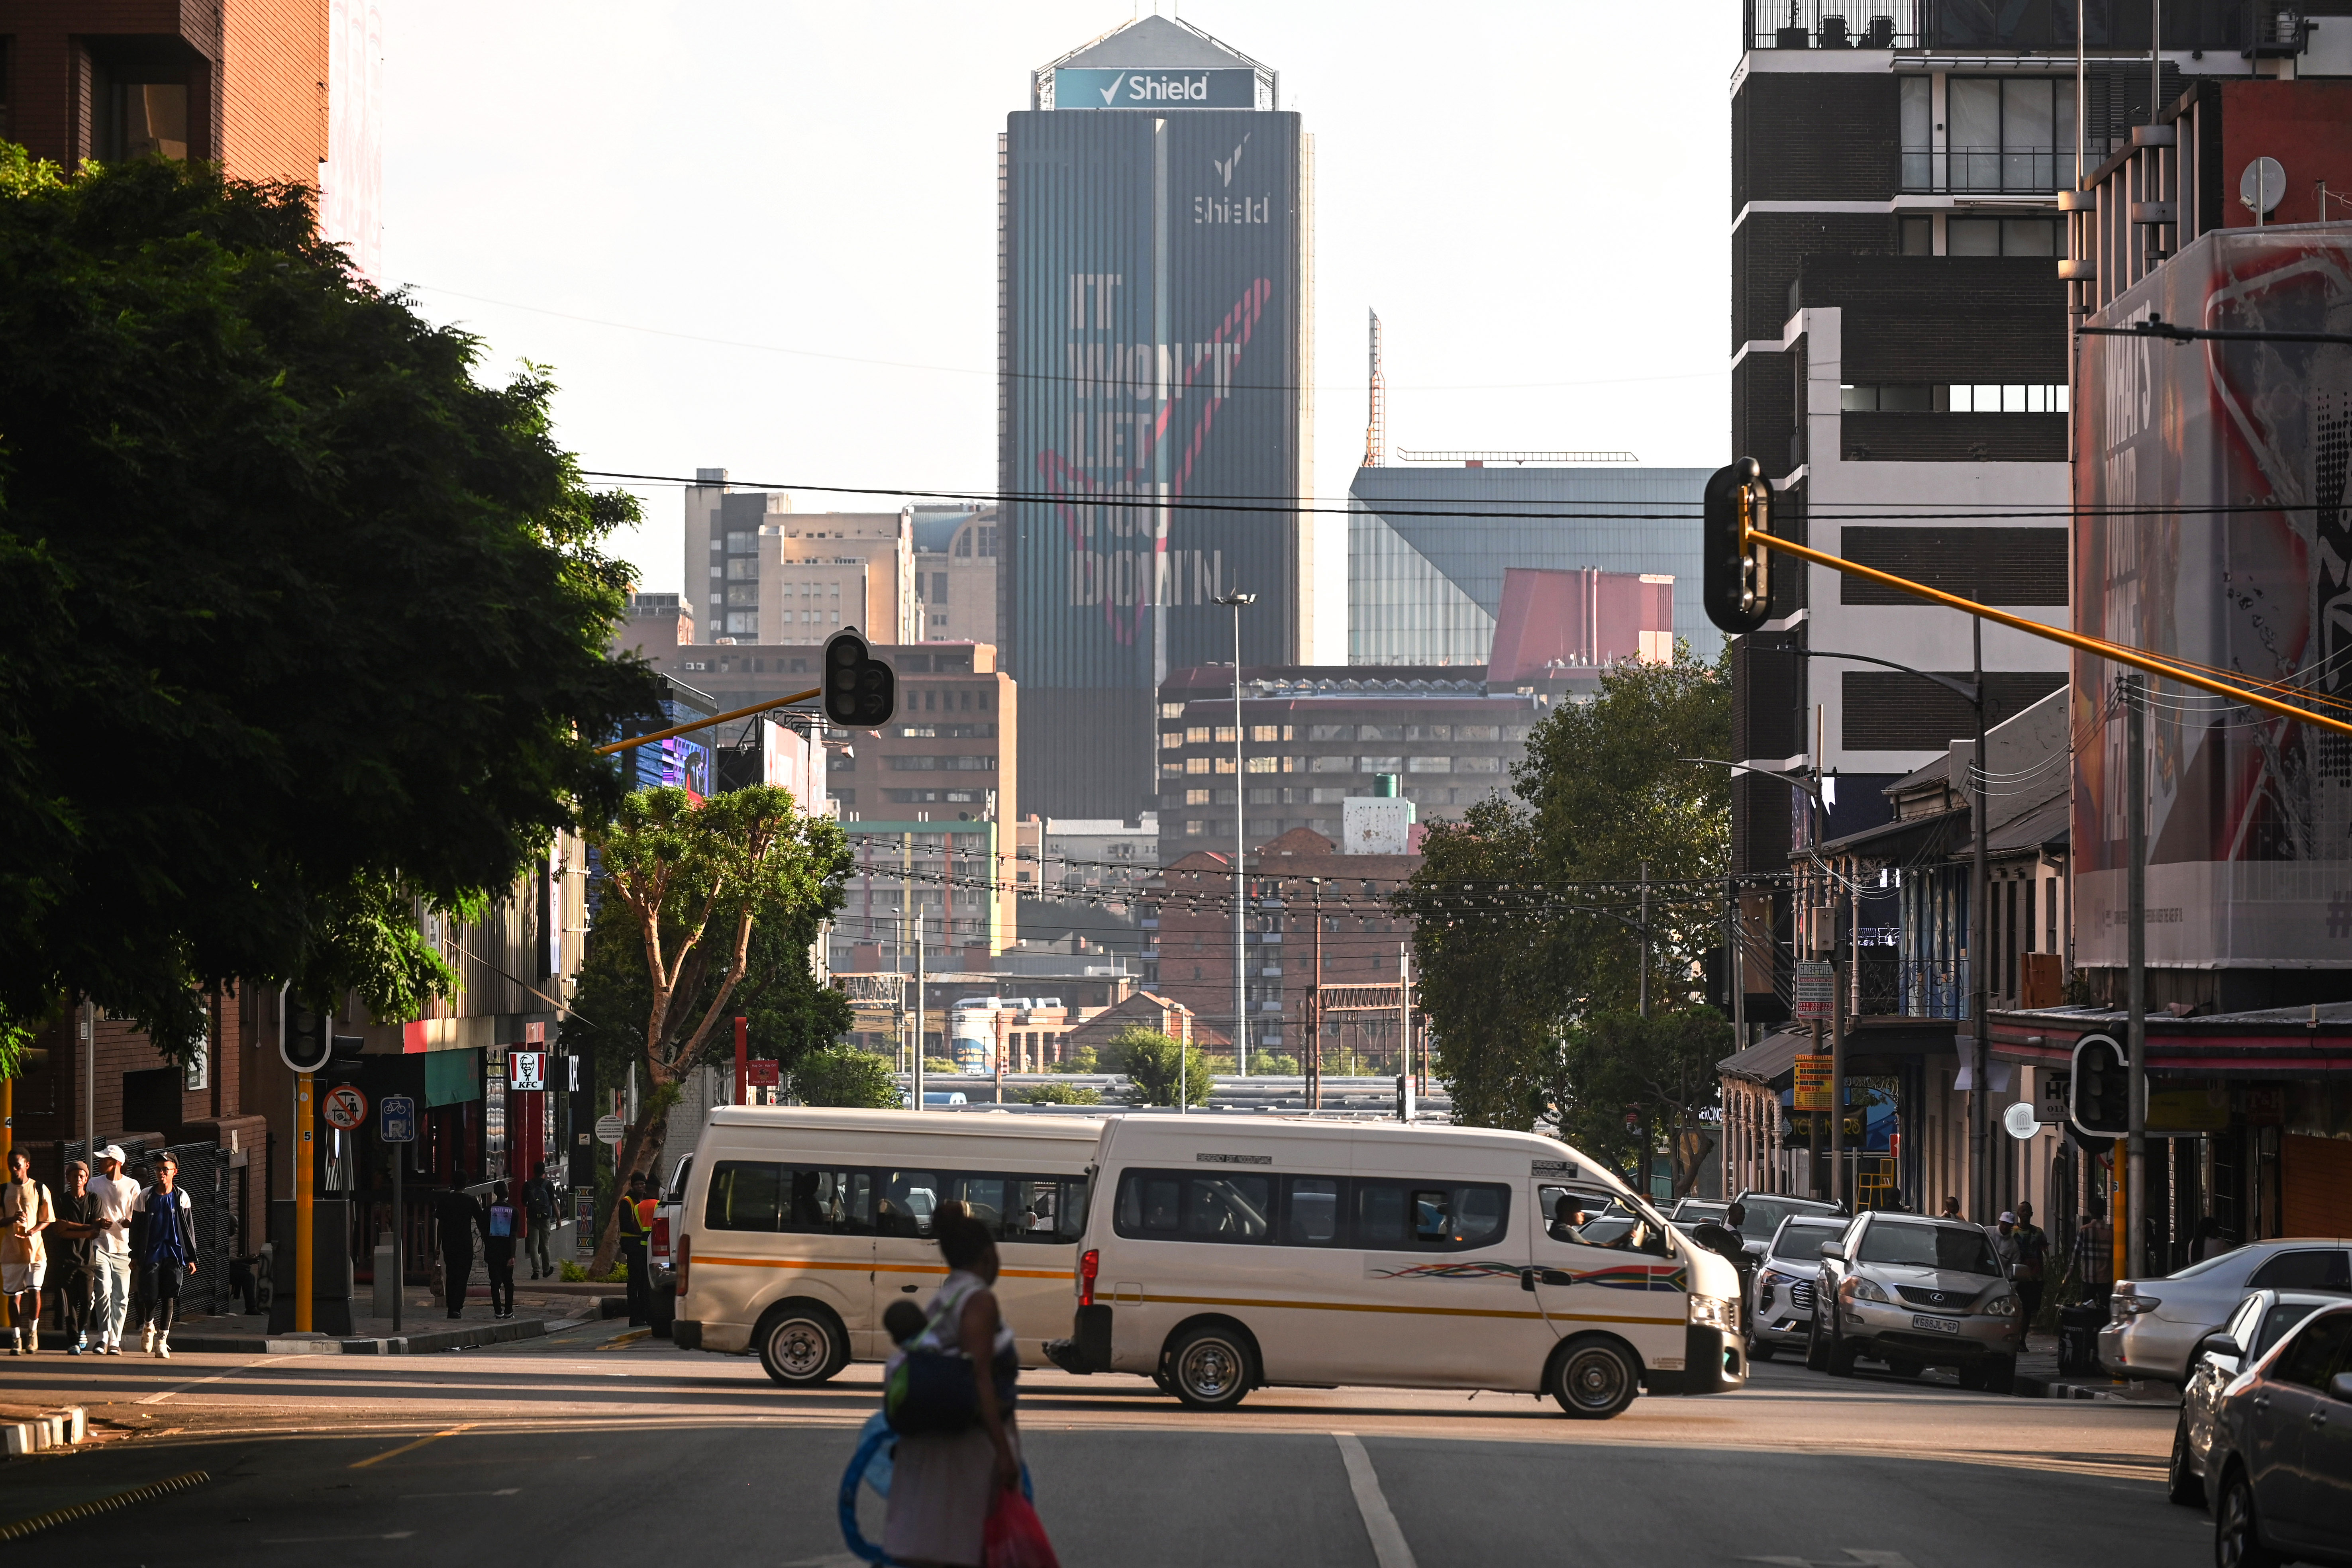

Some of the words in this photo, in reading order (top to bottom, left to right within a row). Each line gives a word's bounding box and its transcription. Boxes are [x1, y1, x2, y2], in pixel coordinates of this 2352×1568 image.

[1129, 76, 1206, 100] Shield
[1195, 197, 1269, 223] Shield
[1070, 274, 1121, 329] IT
[1068, 343, 1240, 400] WON'T
[2106, 300, 2151, 451] WHAT'S
[1069, 413, 1151, 468] LET
[1069, 481, 1168, 538] YOU
[2105, 446, 2136, 580] YOUR
[1069, 549, 1221, 606] DOWN
[569, 1055, 579, 1092] KFC
[5, 1118, 11, 1127] 4
[304, 1131, 311, 1140] 5
[1915, 1317, 1942, 1330] KG88JL
[1947, 1323, 1957, 1332] GP
